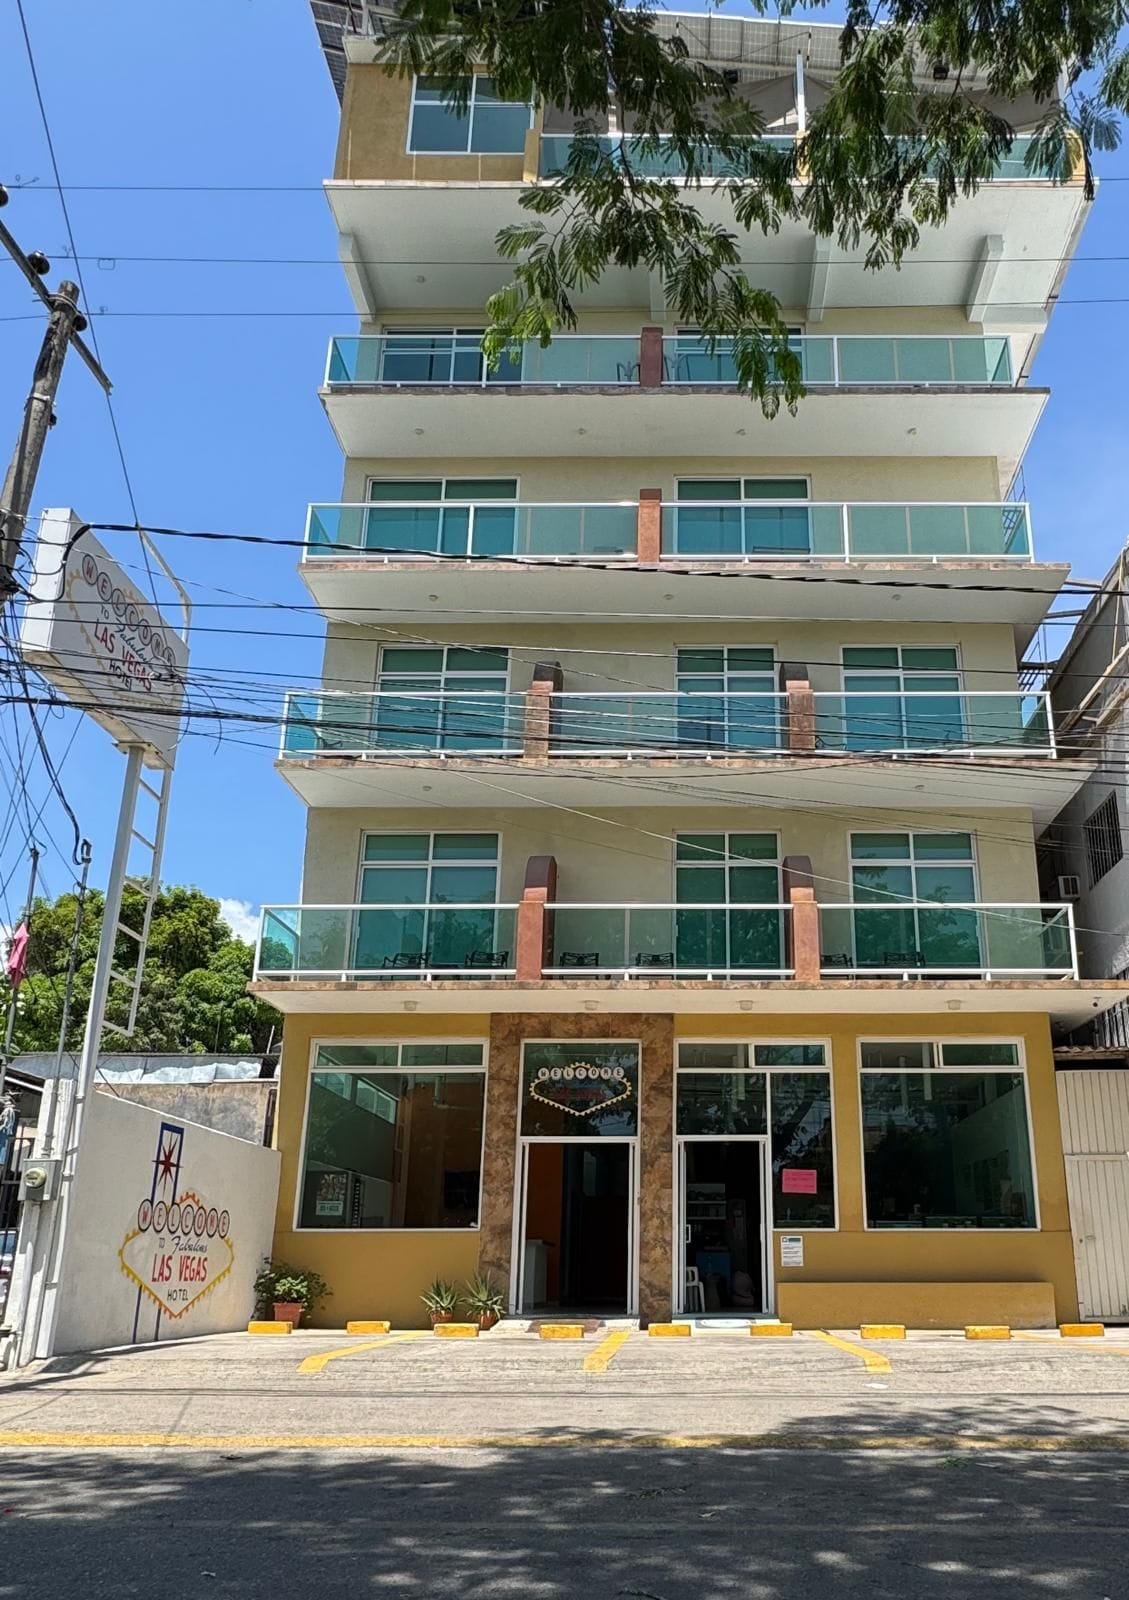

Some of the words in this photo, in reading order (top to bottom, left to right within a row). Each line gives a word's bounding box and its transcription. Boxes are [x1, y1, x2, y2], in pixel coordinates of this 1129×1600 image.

[83, 556, 175, 668] WELCOME
[100, 605, 109, 620] TO
[114, 617, 152, 668] Fabulou
[94, 618, 115, 653] LAS
[122, 645, 152, 691] VEGAS
[109, 659, 132, 691] HOTEL
[539, 1067, 623, 1078] WELCOME
[139, 1202, 228, 1236] WELCOME
[158, 1237, 166, 1249] TO
[152, 1253, 172, 1282] LAS
[178, 1254, 208, 1282] VEGAS
[167, 1288, 188, 1302] HOTEL
